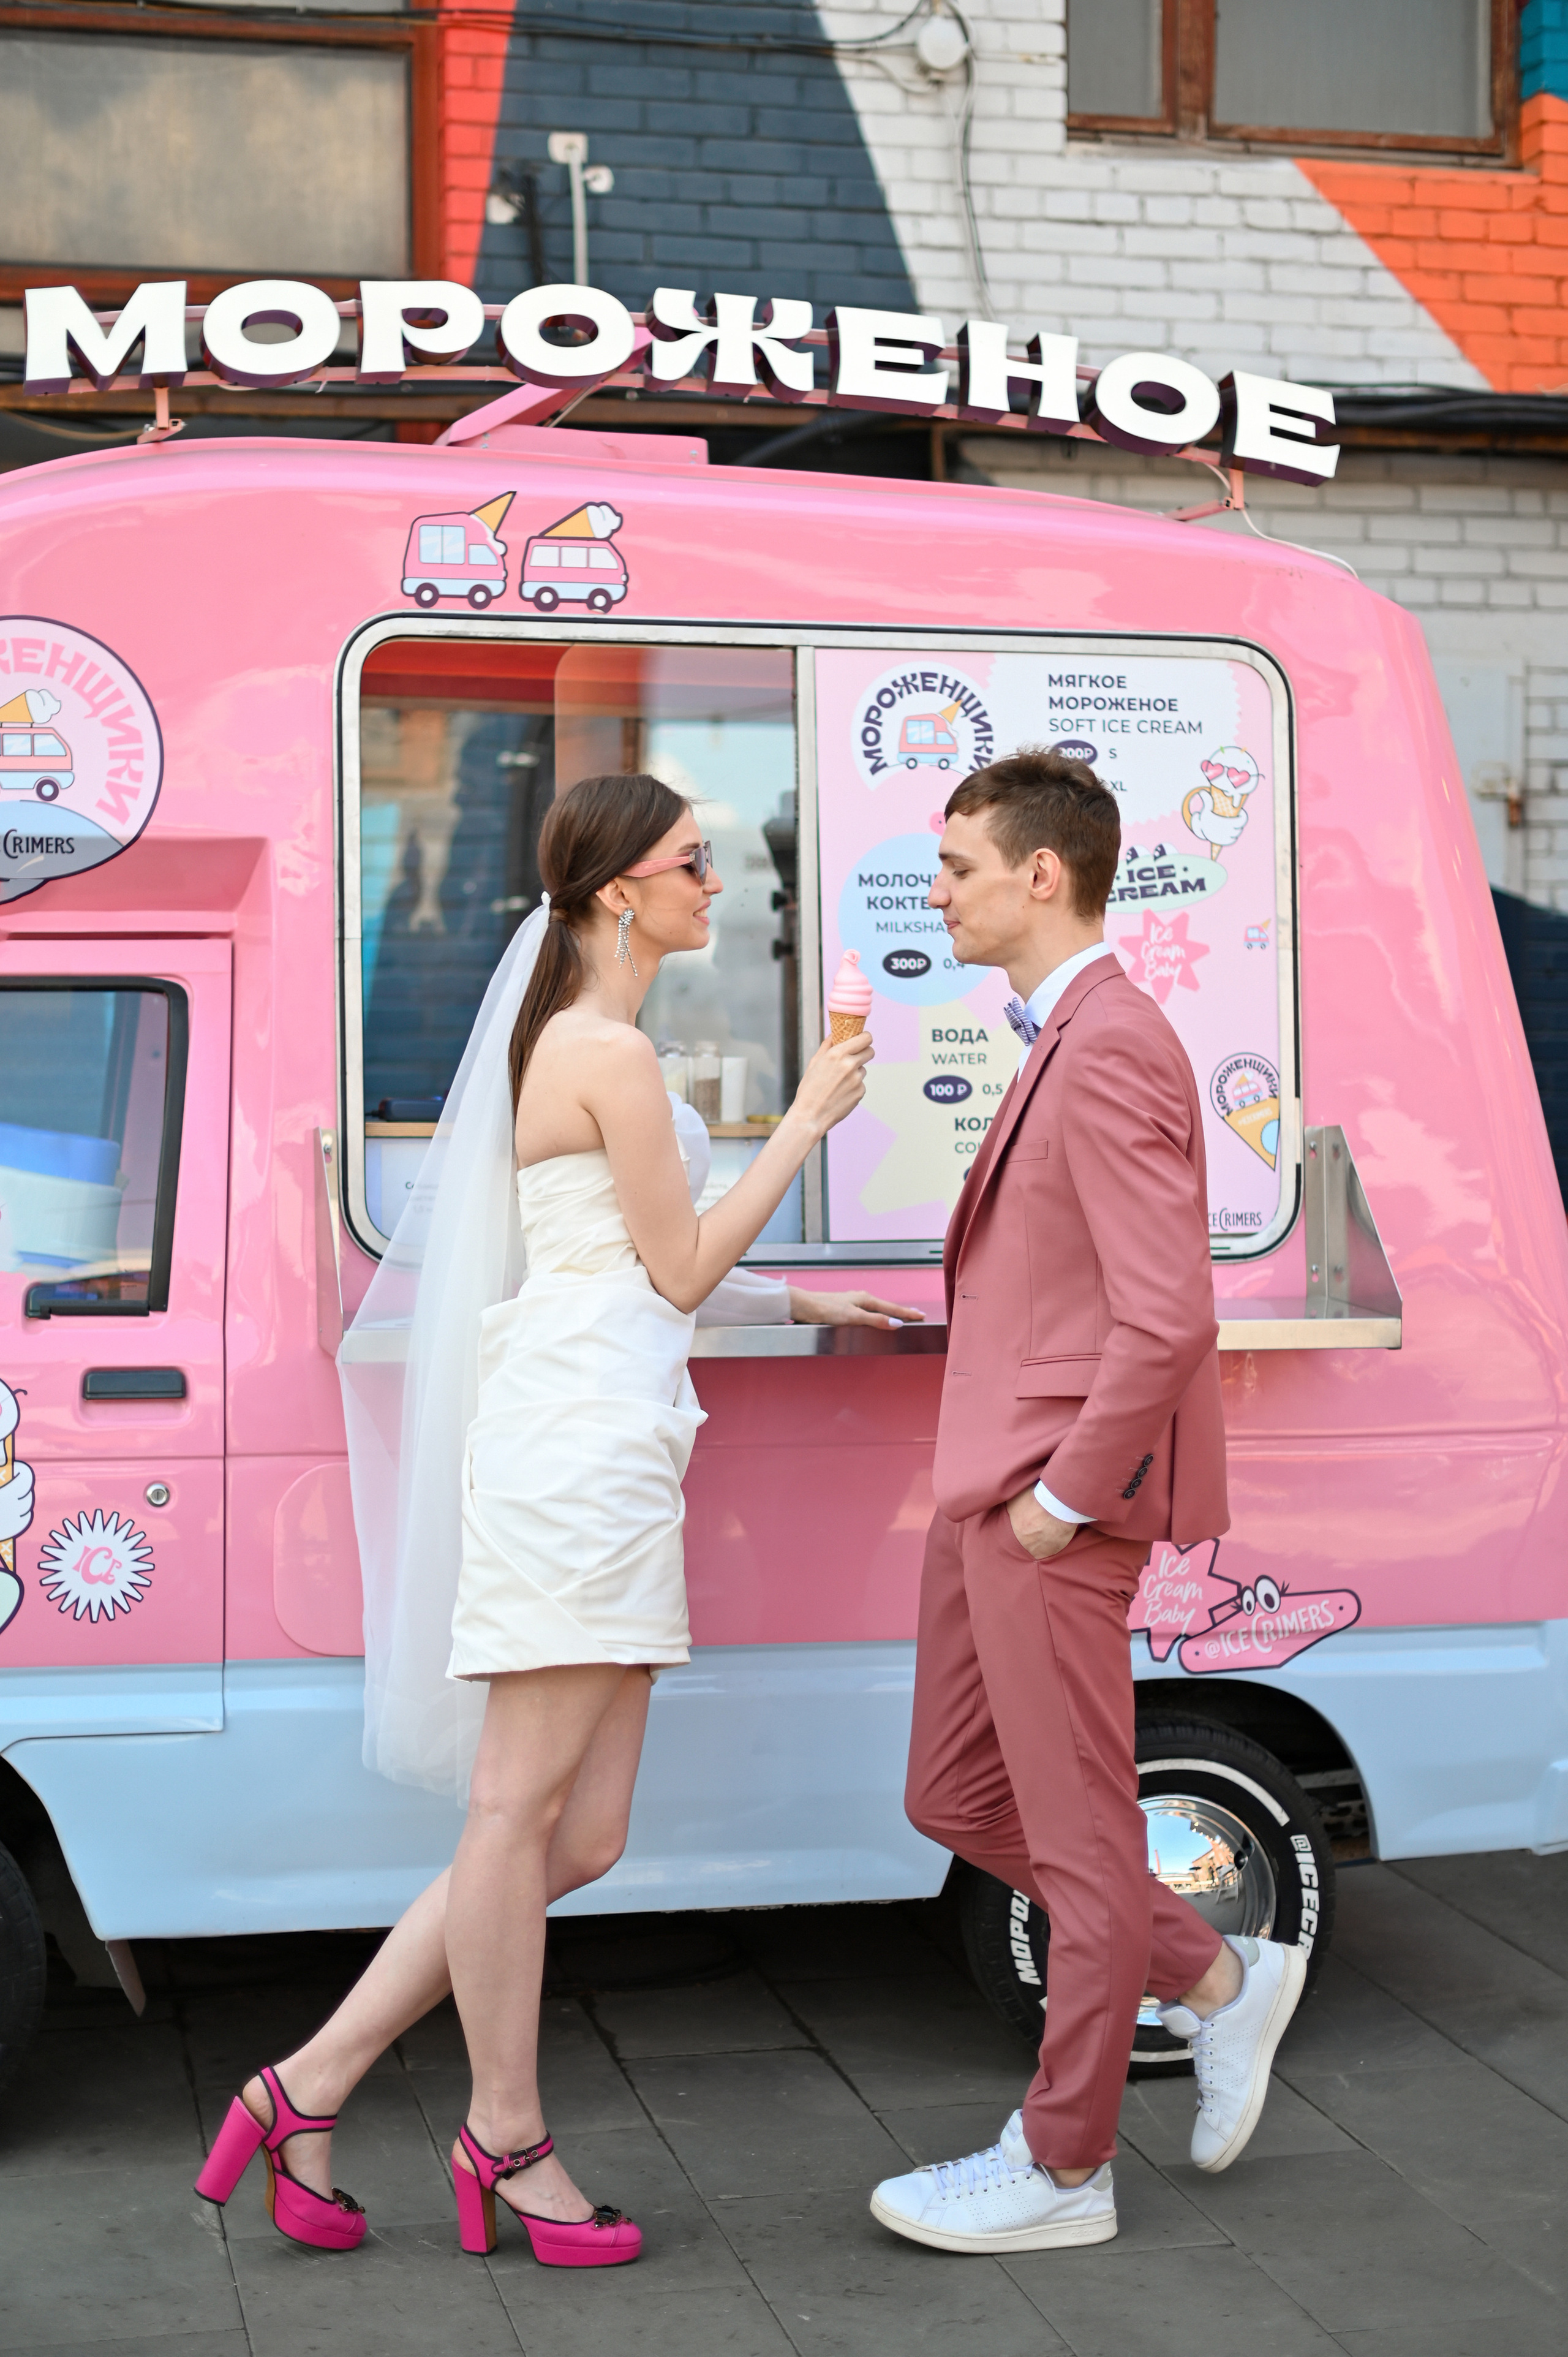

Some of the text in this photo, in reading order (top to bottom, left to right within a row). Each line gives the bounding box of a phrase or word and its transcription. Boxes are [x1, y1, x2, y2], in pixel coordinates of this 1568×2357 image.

[23, 279, 1340, 487] МОРОЖЕНОЕ
[1048, 674, 1127, 689] МЯГКОЕ
[1049, 696, 1178, 712] МОРОЖЕНОЕ
[1049, 718, 1203, 734] SOFT ICE CREAM
[1109, 747, 1117, 759] S
[1110, 781, 1128, 792] XL
[0, 828, 75, 859] CRIMERS
[858, 874, 937, 887] МОЛОЧ
[1126, 864, 1176, 883] ICE
[1150, 922, 1174, 944] Ice
[1144, 960, 1182, 988] Baby
[932, 1029, 989, 1044] ВОДА
[932, 1053, 987, 1065] WATER
[982, 1084, 1003, 1096] 0,5
[1158, 1549, 1191, 1578] Ice
[1143, 1573, 1204, 1601] Cream
[1143, 1600, 1197, 1636] Baby
